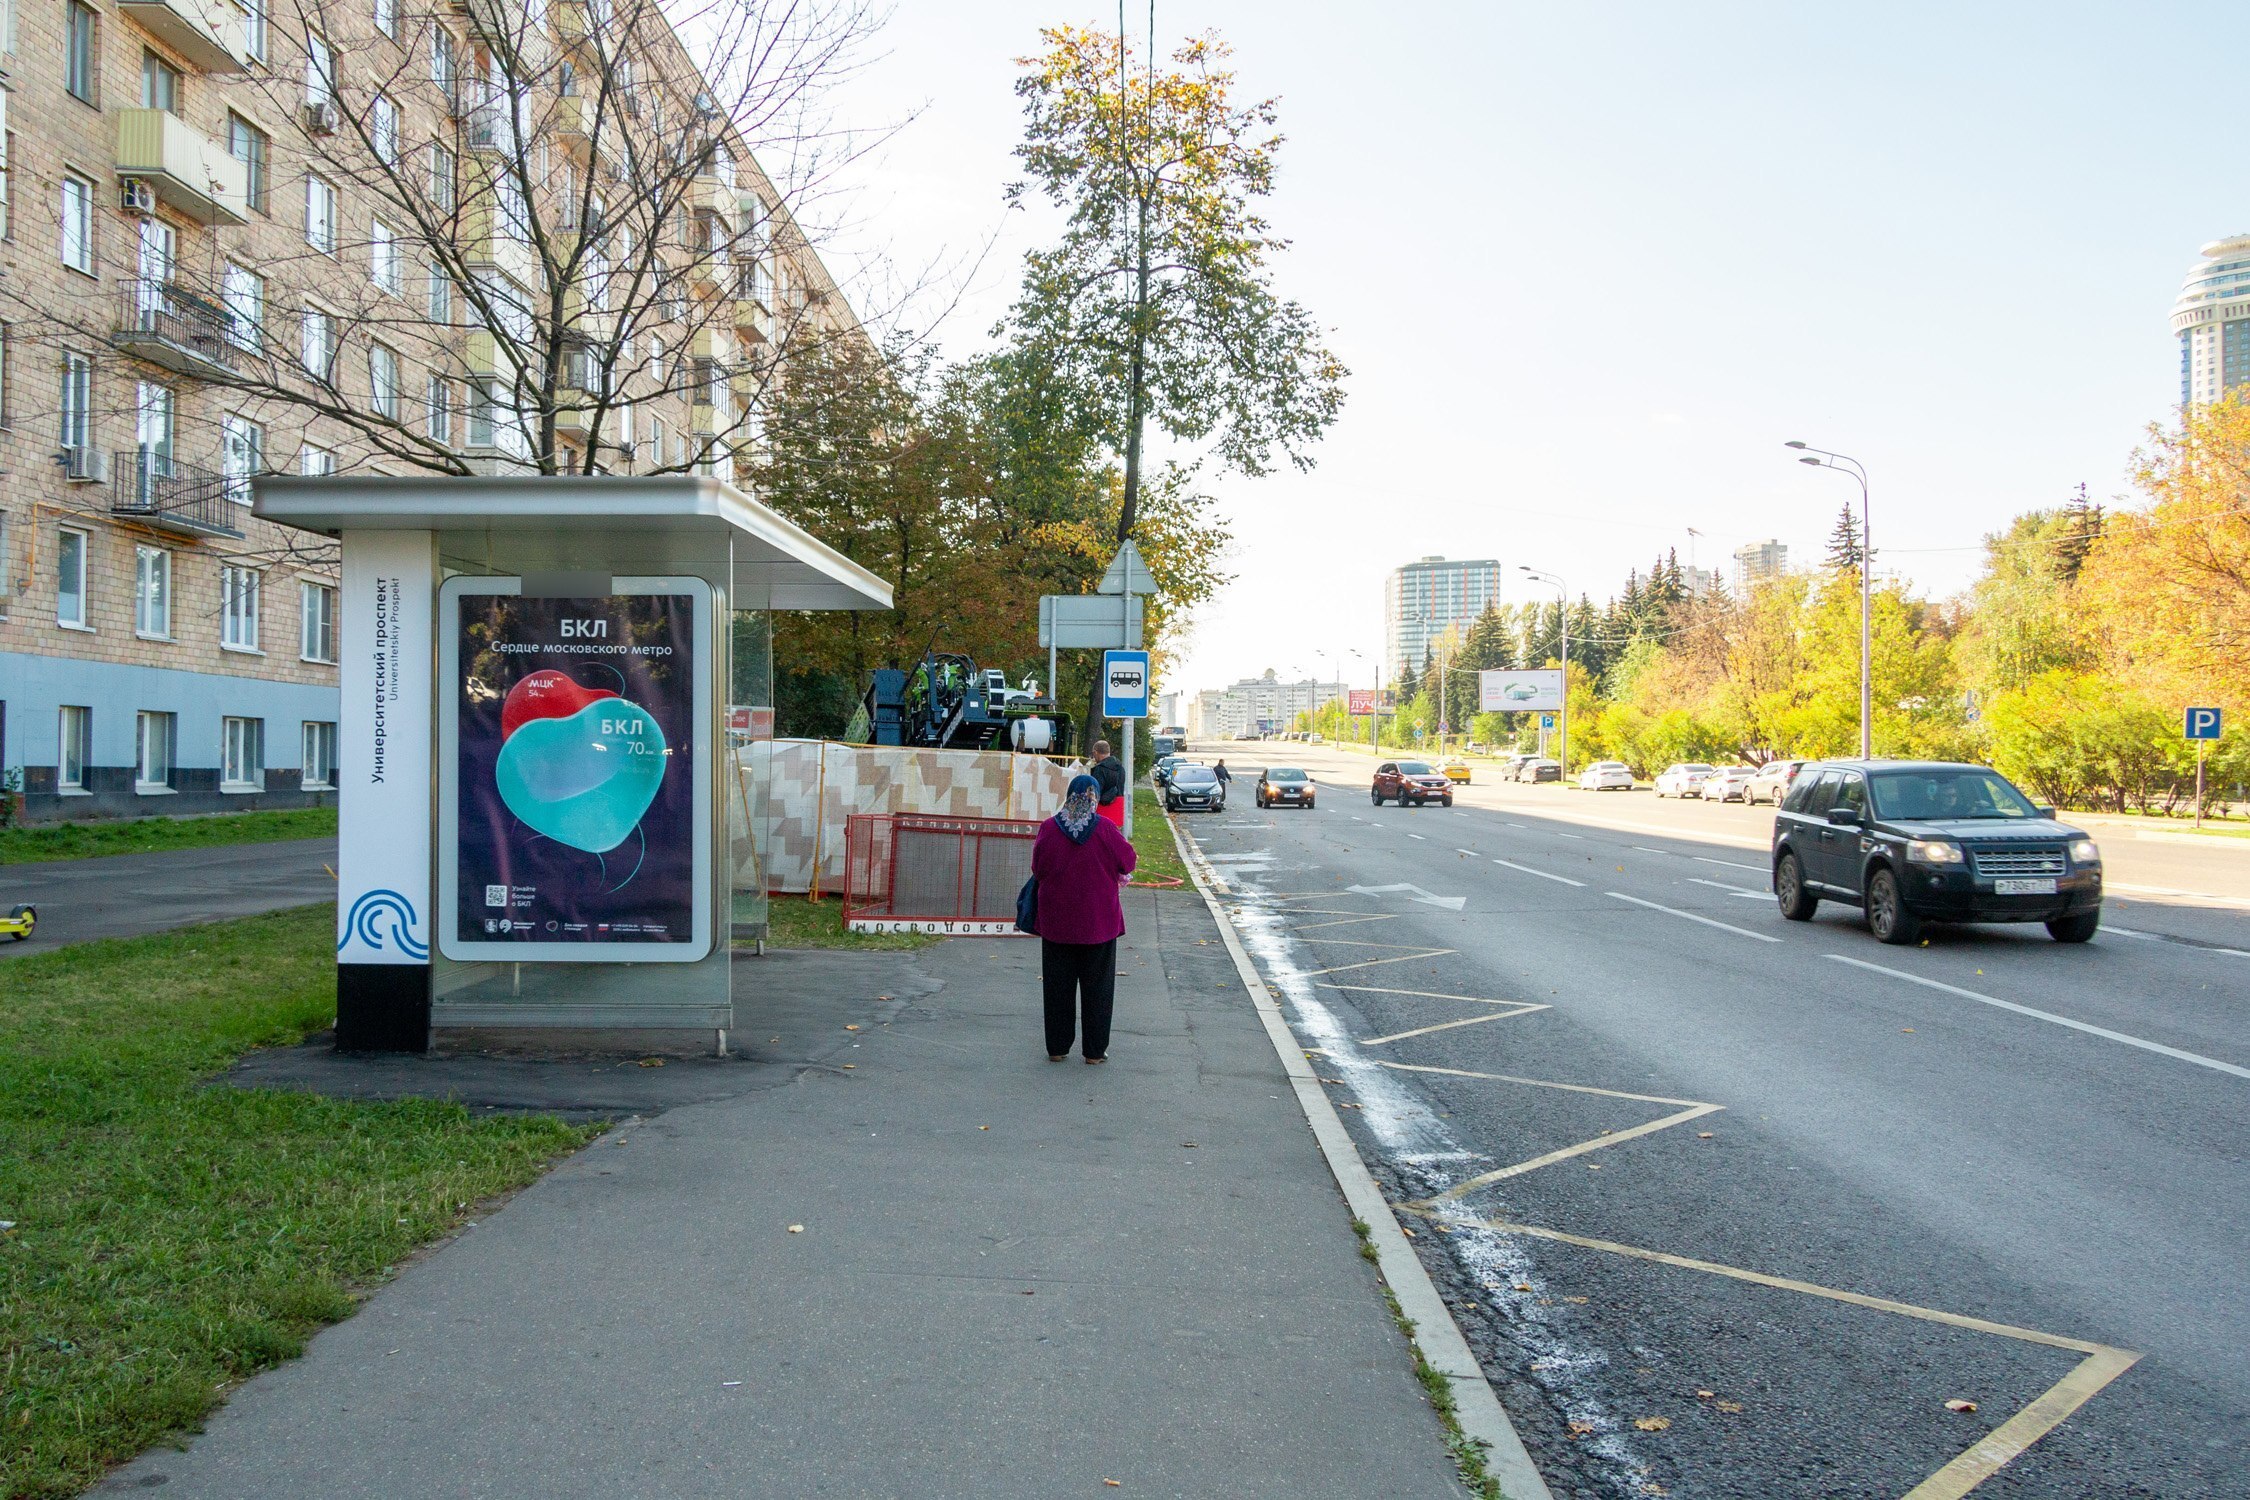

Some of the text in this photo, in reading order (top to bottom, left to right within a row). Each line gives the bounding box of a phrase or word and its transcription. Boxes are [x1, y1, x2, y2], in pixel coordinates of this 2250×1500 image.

[560, 619, 607, 638] БКЛ
[389, 577, 401, 701] Universitetskiy Prospekt
[491, 640, 673, 658] Сердце московского метро
[371, 577, 389, 784] Университетский проспект
[528, 679, 554, 689] МЦК
[527, 689, 539, 697] 54
[601, 719, 643, 735] БКЛ
[1544, 717, 1552, 727] P
[2194, 710, 2216, 736] P
[626, 741, 645, 755] 70
[511, 885, 537, 893] Узнайте
[511, 892, 536, 900] больше
